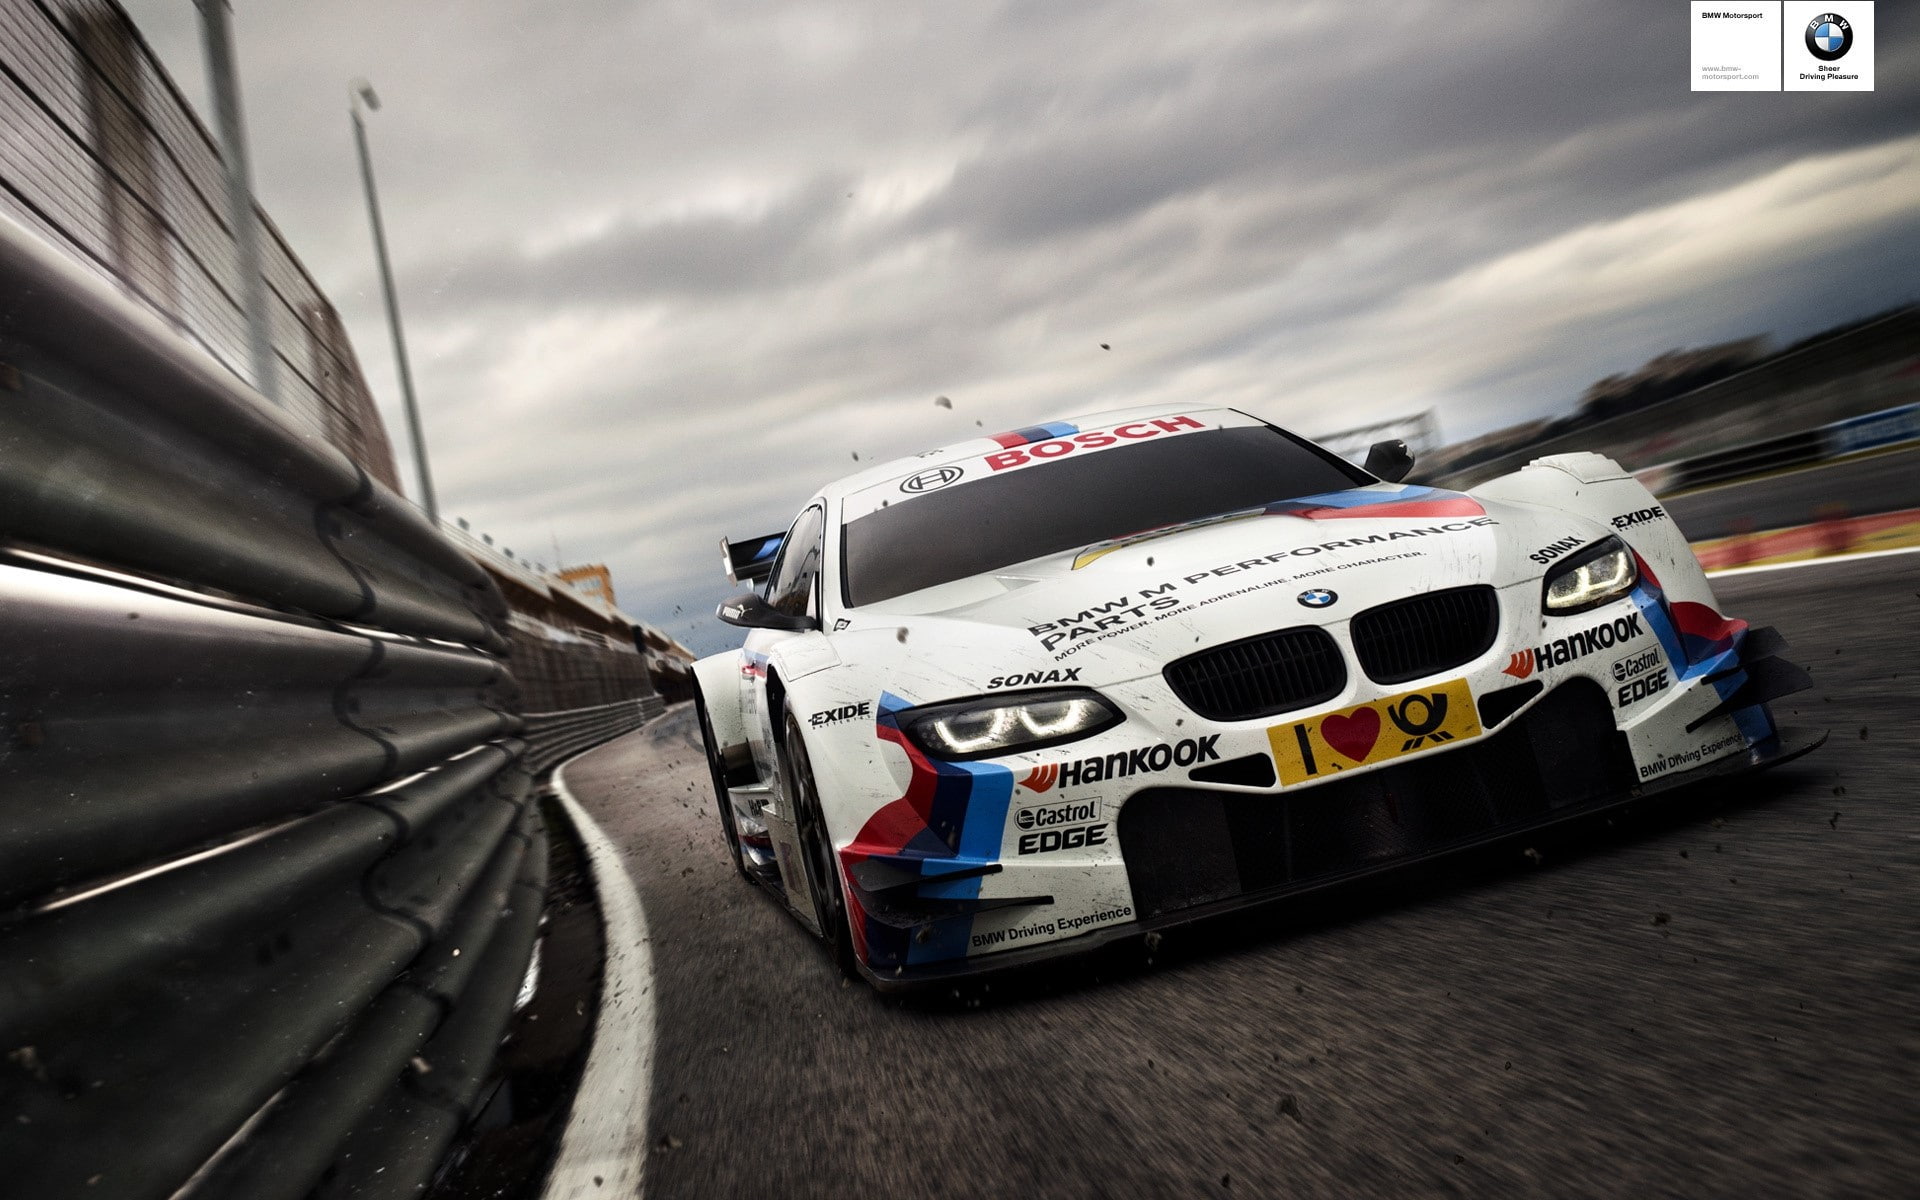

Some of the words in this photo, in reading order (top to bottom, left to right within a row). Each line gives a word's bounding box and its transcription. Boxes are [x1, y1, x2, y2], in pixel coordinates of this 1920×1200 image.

[984, 415, 1207, 471] BOSCH
[1610, 506, 1665, 528] EXIDE
[1529, 535, 1586, 565] SONAX
[1027, 596, 1130, 637] BMW
[1138, 582, 1178, 599] M
[1183, 516, 1501, 585] PERFORMANCE
[1040, 596, 1181, 652] PARTS
[1054, 638, 1096, 662] MORE
[1099, 620, 1153, 641] POWER.
[1155, 603, 1197, 622] MORE
[1199, 578, 1292, 607] ADRENALINE.
[1293, 566, 1336, 580] MORE
[1337, 550, 1428, 570] CHARACTER.
[987, 667, 1082, 689] SONAX
[1625, 648, 1661, 677] Castrol
[1618, 667, 1670, 708] EDGE
[808, 702, 870, 726] EXIDE
[1294, 723, 1318, 775] I
[1640, 759, 1667, 778] BMW
[1668, 750, 1701, 768] Driving
[1700, 733, 1743, 756] Experience
[1035, 801, 1096, 827] Castrol
[1018, 823, 1109, 855] EDGE
[972, 930, 1006, 947] BMW
[1008, 923, 1055, 941] Driving
[1057, 906, 1132, 930] Experience
